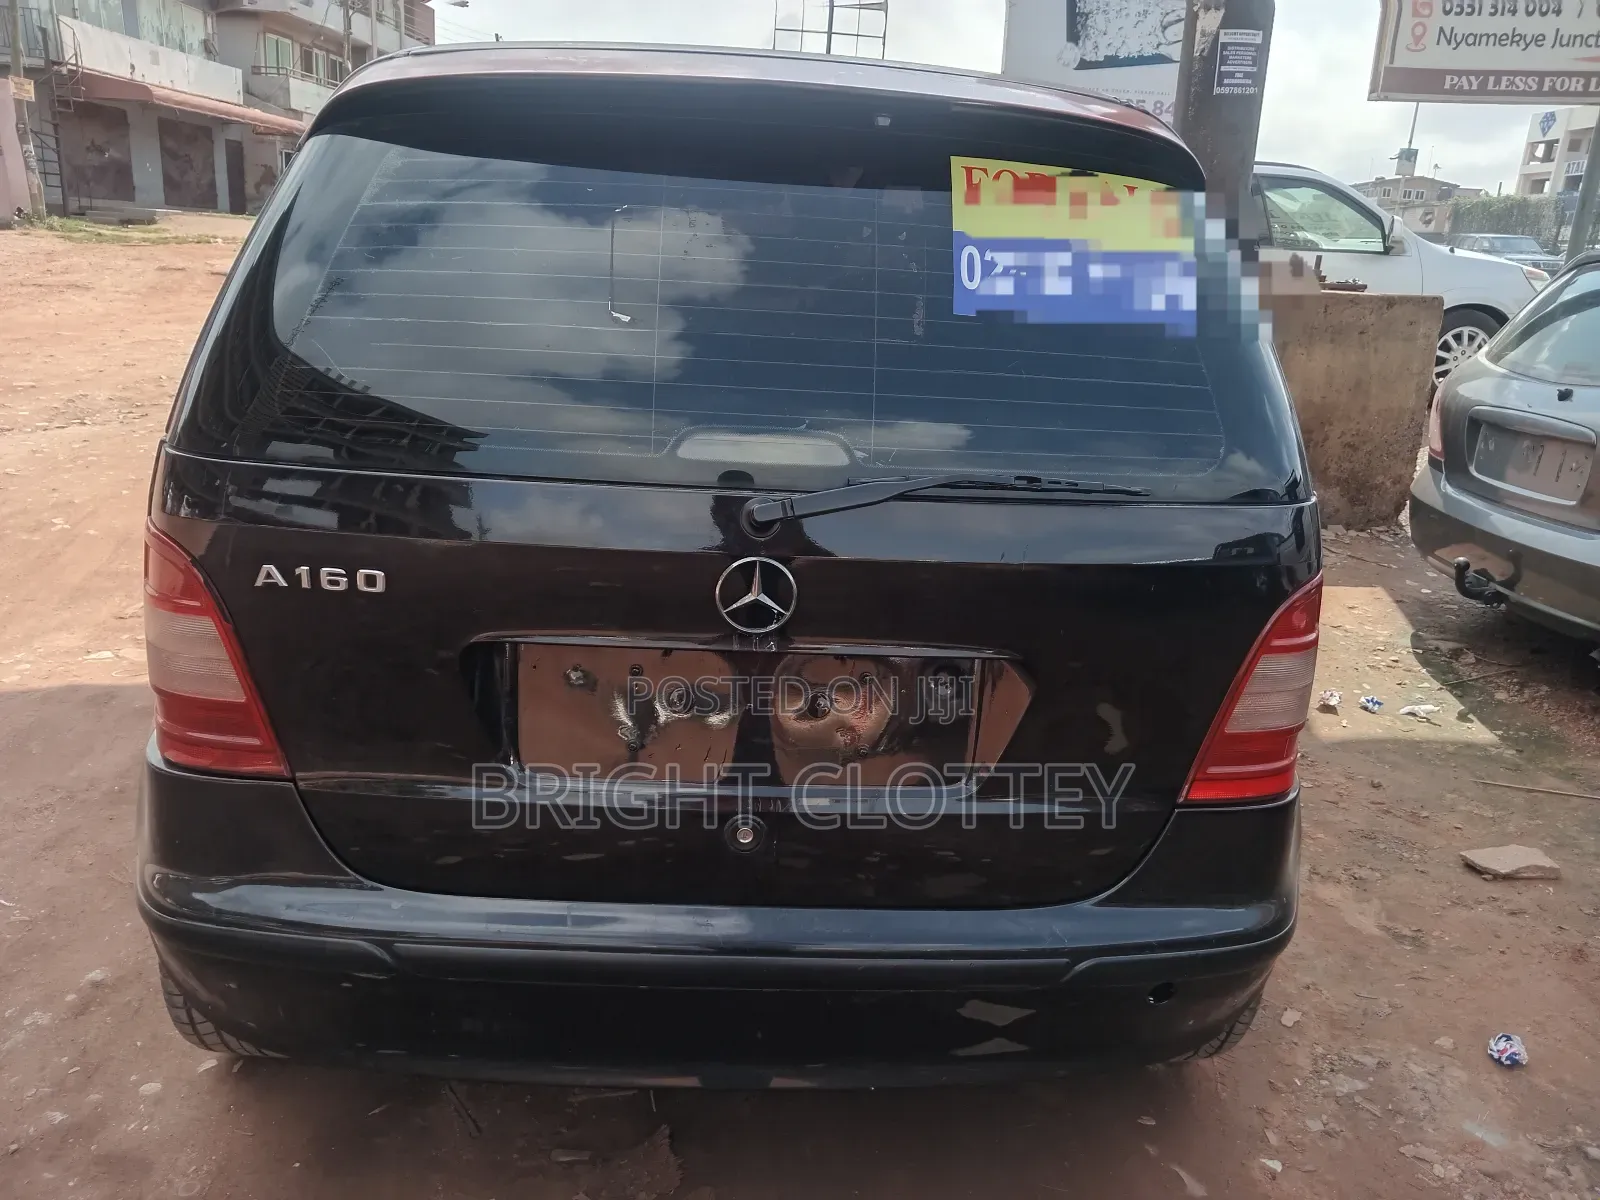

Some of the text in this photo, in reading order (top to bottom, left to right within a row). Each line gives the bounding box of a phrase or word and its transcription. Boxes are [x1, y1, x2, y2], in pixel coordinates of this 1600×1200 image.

[1436, 26, 1546, 51] Nyamekye
[1443, 75, 1484, 90] PAY
[1487, 76, 1538, 91] LESS
[1542, 76, 1584, 92] FOR
[254, 564, 386, 593] A160
